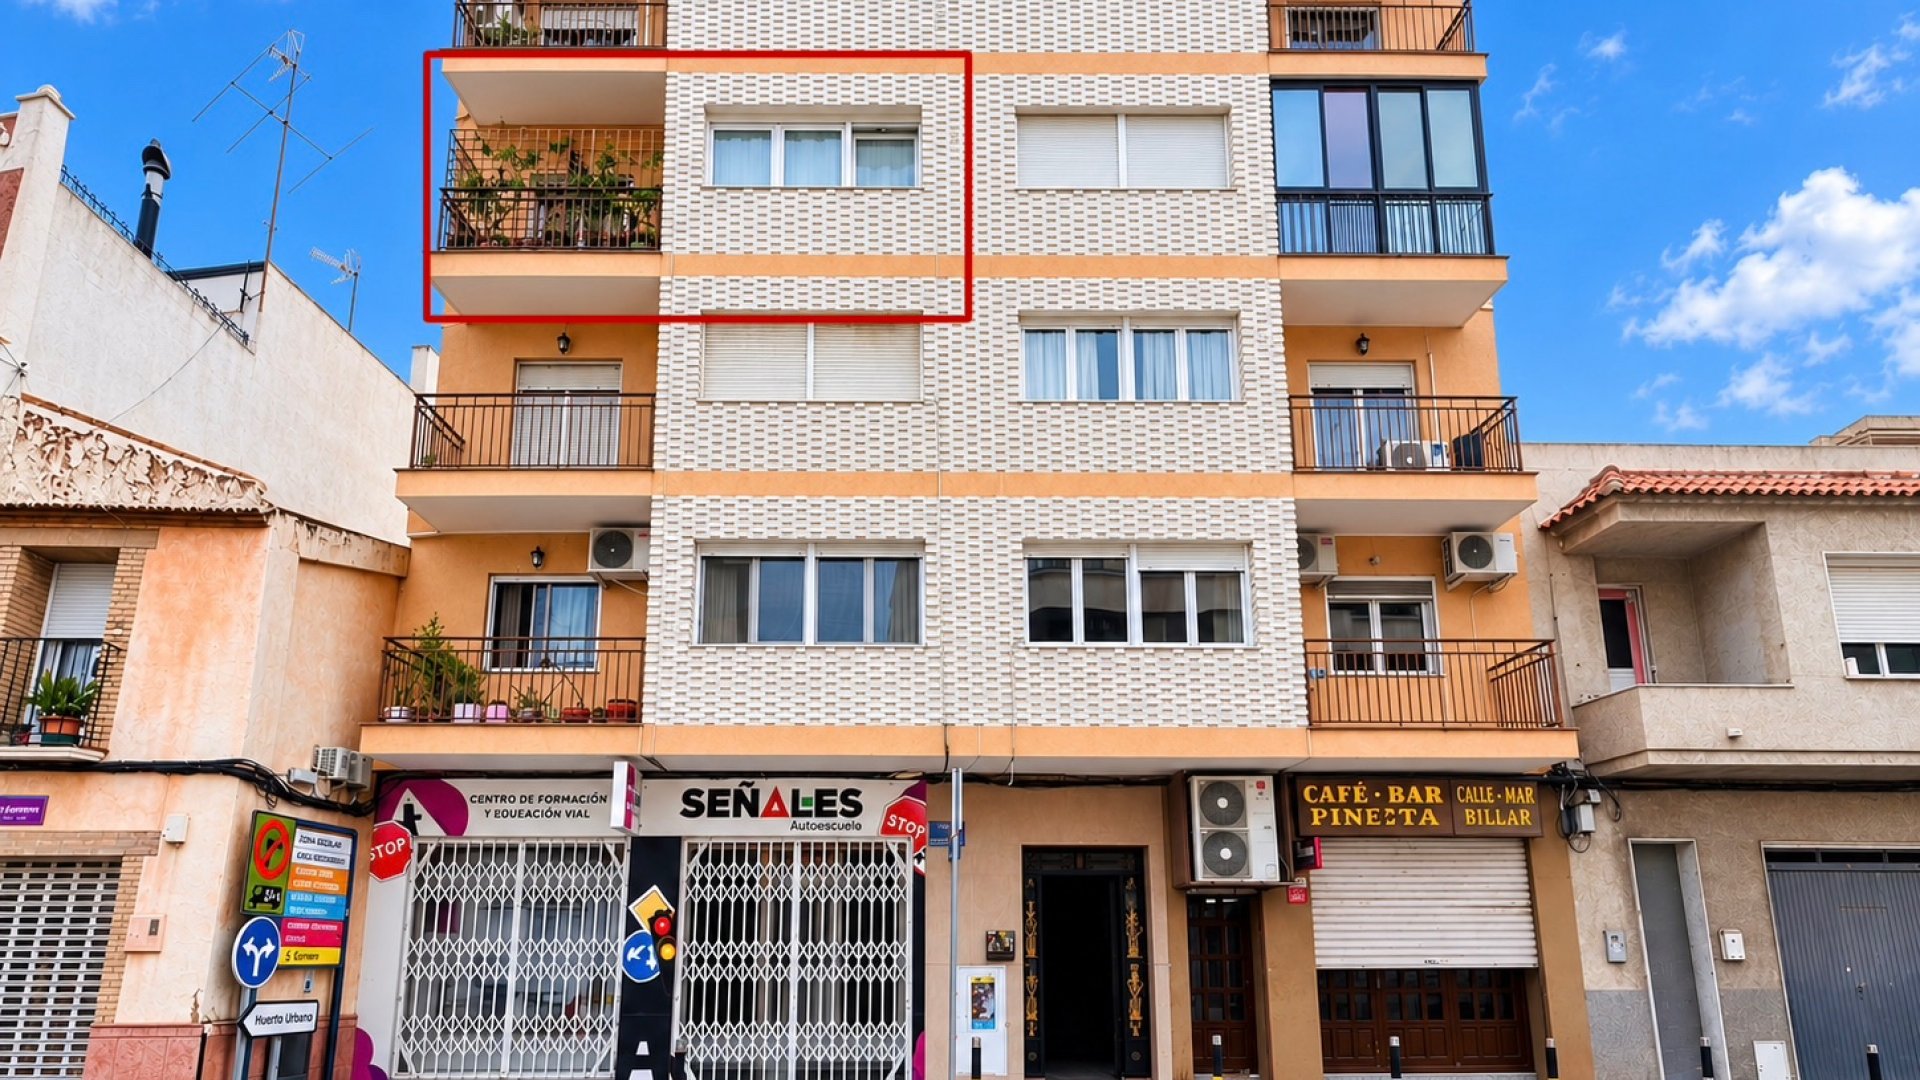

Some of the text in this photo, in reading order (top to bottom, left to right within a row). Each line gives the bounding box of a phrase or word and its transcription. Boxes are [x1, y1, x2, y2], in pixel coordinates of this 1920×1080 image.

[470, 791, 608, 804] CENTRO DE FORMACIÓN
[680, 781, 863, 818] SEÑALES
[1303, 781, 1444, 804] CAFÉ BAR
[1456, 786, 1535, 804] CALLE MAR
[484, 809, 491, 818] Y
[565, 809, 590, 819] VIAL
[1464, 808, 1532, 826] BILLAR
[886, 814, 926, 839] STOP
